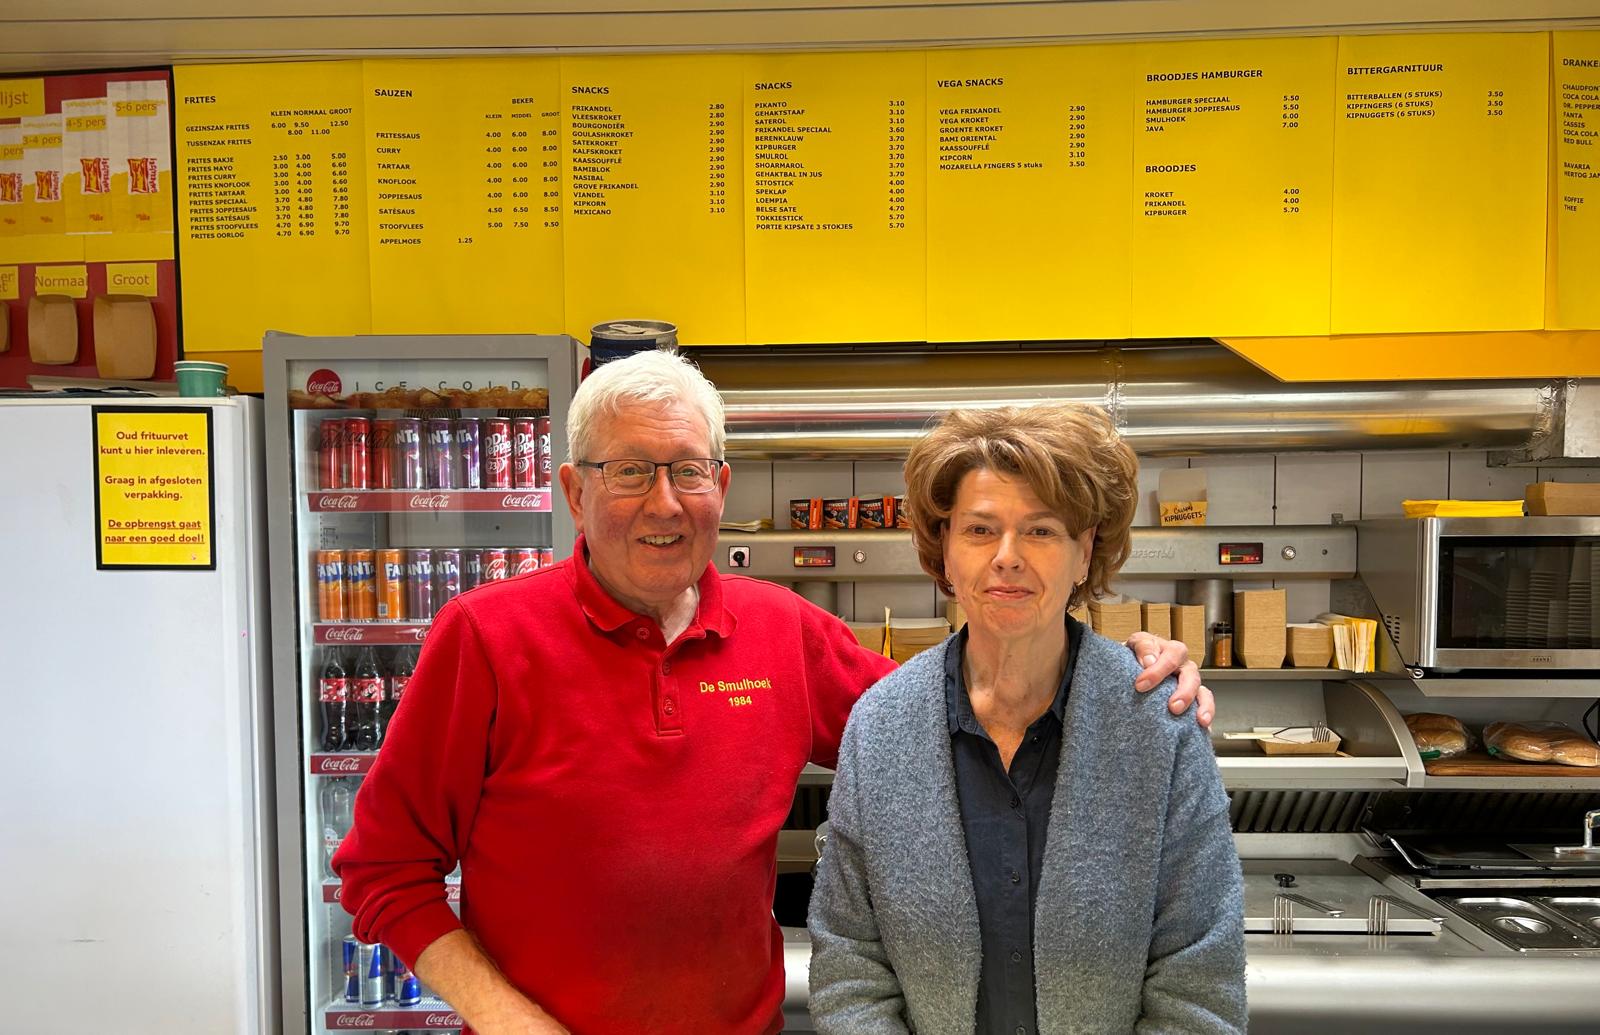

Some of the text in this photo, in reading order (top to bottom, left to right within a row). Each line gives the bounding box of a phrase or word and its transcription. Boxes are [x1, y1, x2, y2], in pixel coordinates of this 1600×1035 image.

[1562, 58, 1600, 68] DRANKE
[1347, 63, 1444, 76] BITTERGARNITUUR
[1146, 69, 1263, 82] BROODJES HAMBURGER
[754, 81, 793, 91] SNACKS
[936, 77, 1004, 88] VEGA SNACKS
[374, 88, 413, 98] SAUZEN
[571, 86, 610, 95] SNACKS
[1346, 90, 1504, 101] BITTERBALLEN (5 STUKS) 3.50
[184, 95, 216, 105] FRITES
[511, 97, 534, 105] BEKER
[754, 101, 788, 109] PIKANTO
[1146, 94, 1300, 106] HAMBURGER SPECIAAL 5.50
[115, 102, 157, 113] 5-6 pers
[328, 107, 352, 115] GROOT
[939, 108, 959, 116] VEGA
[960, 107, 1002, 115] FRIKANDEL
[571, 113, 622, 121] VLEESKROKET
[1145, 112, 1299, 124] SMULHOEK 6.00
[1346, 111, 1395, 119] KIPNUGGETS
[1396, 110, 1406, 119] (6
[1406, 109, 1436, 118] STUKS)
[1563, 111, 1583, 119] FANTA
[66, 118, 106, 128] 4-5 pers
[185, 124, 225, 132] GEZINSZAK
[225, 123, 250, 131] FRITES
[1563, 120, 1586, 129] CASSIS
[572, 130, 634, 138] GOULASHKROKET
[754, 126, 905, 134] FRIKANDEL SPECIAAL 3.60
[939, 126, 973, 134] GROENTE
[23, 135, 62, 146] 3-4 pers
[186, 138, 252, 147] TUSSENZAK FRITES
[542, 144, 558, 152] 8.00
[754, 152, 905, 160] SMULROL 3.70
[939, 150, 1086, 162] KIPCORN 3.10
[939, 163, 983, 171] MOZARELLA
[983, 162, 1016, 170] FINGERS
[1023, 161, 1043, 169] stuks
[1069, 160, 1086, 168] 3.50
[1145, 164, 1197, 174] BROODJES
[572, 182, 598, 190] GROVE
[1144, 206, 1300, 217] KIPBURGER 5.70
[1564, 204, 1578, 212] THEE
[543, 220, 560, 228] 9.50
[784, 223, 815, 231] KIPSATE
[190, 232, 216, 240] FRITES
[216, 231, 245, 239] OORLOG
[334, 228, 350, 236] 9.70
[112, 274, 150, 286] Groot
[116, 431, 189, 440] Oud frituurvet
[100, 446, 123, 455] kunt
[134, 446, 154, 455] hier
[156, 446, 205, 455] inleveren.
[104, 475, 202, 486] Graag in afgesloten
[124, 490, 183, 501] verpakking.
[1164, 512, 1202, 522] KIPNUGGETS
[108, 519, 201, 530] De opbrengst gaat
[105, 534, 204, 544] naar een goed doel!
[700, 678, 772, 693] De Smulhoek
[728, 696, 752, 706] 1984
